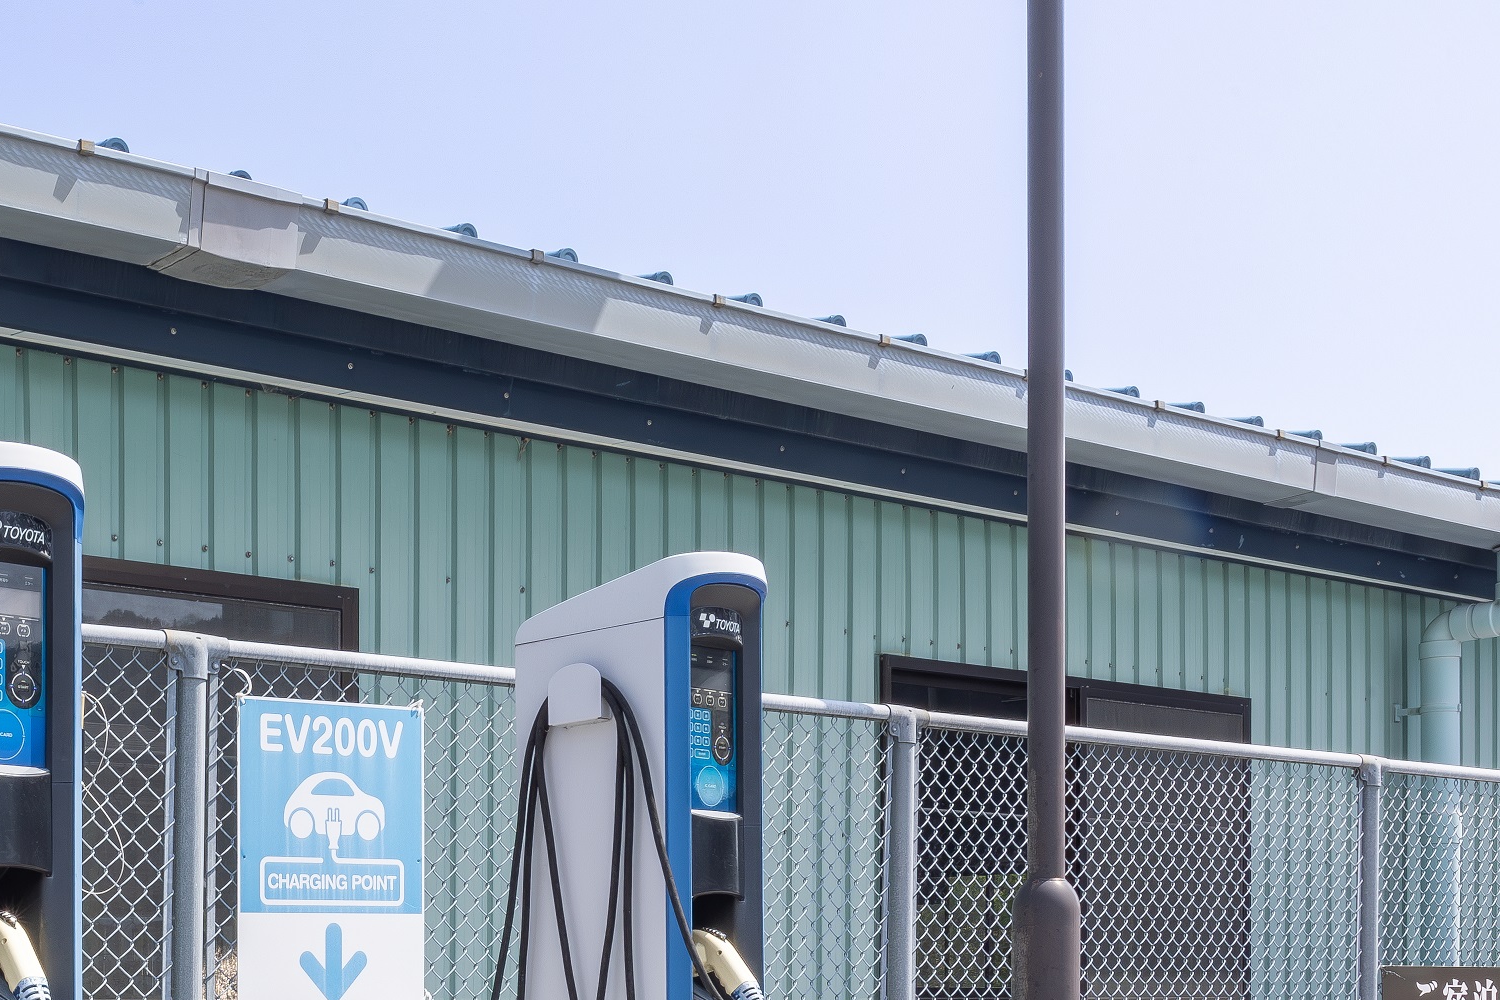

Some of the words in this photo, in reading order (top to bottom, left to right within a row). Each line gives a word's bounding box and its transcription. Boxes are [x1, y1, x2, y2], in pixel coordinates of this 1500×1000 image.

[4, 525, 45, 545] TOYOTA
[716, 618, 740, 633] TOYOTA
[260, 713, 404, 759] EV200V
[267, 873, 348, 890] CHARGING
[351, 875, 397, 891] POINT
